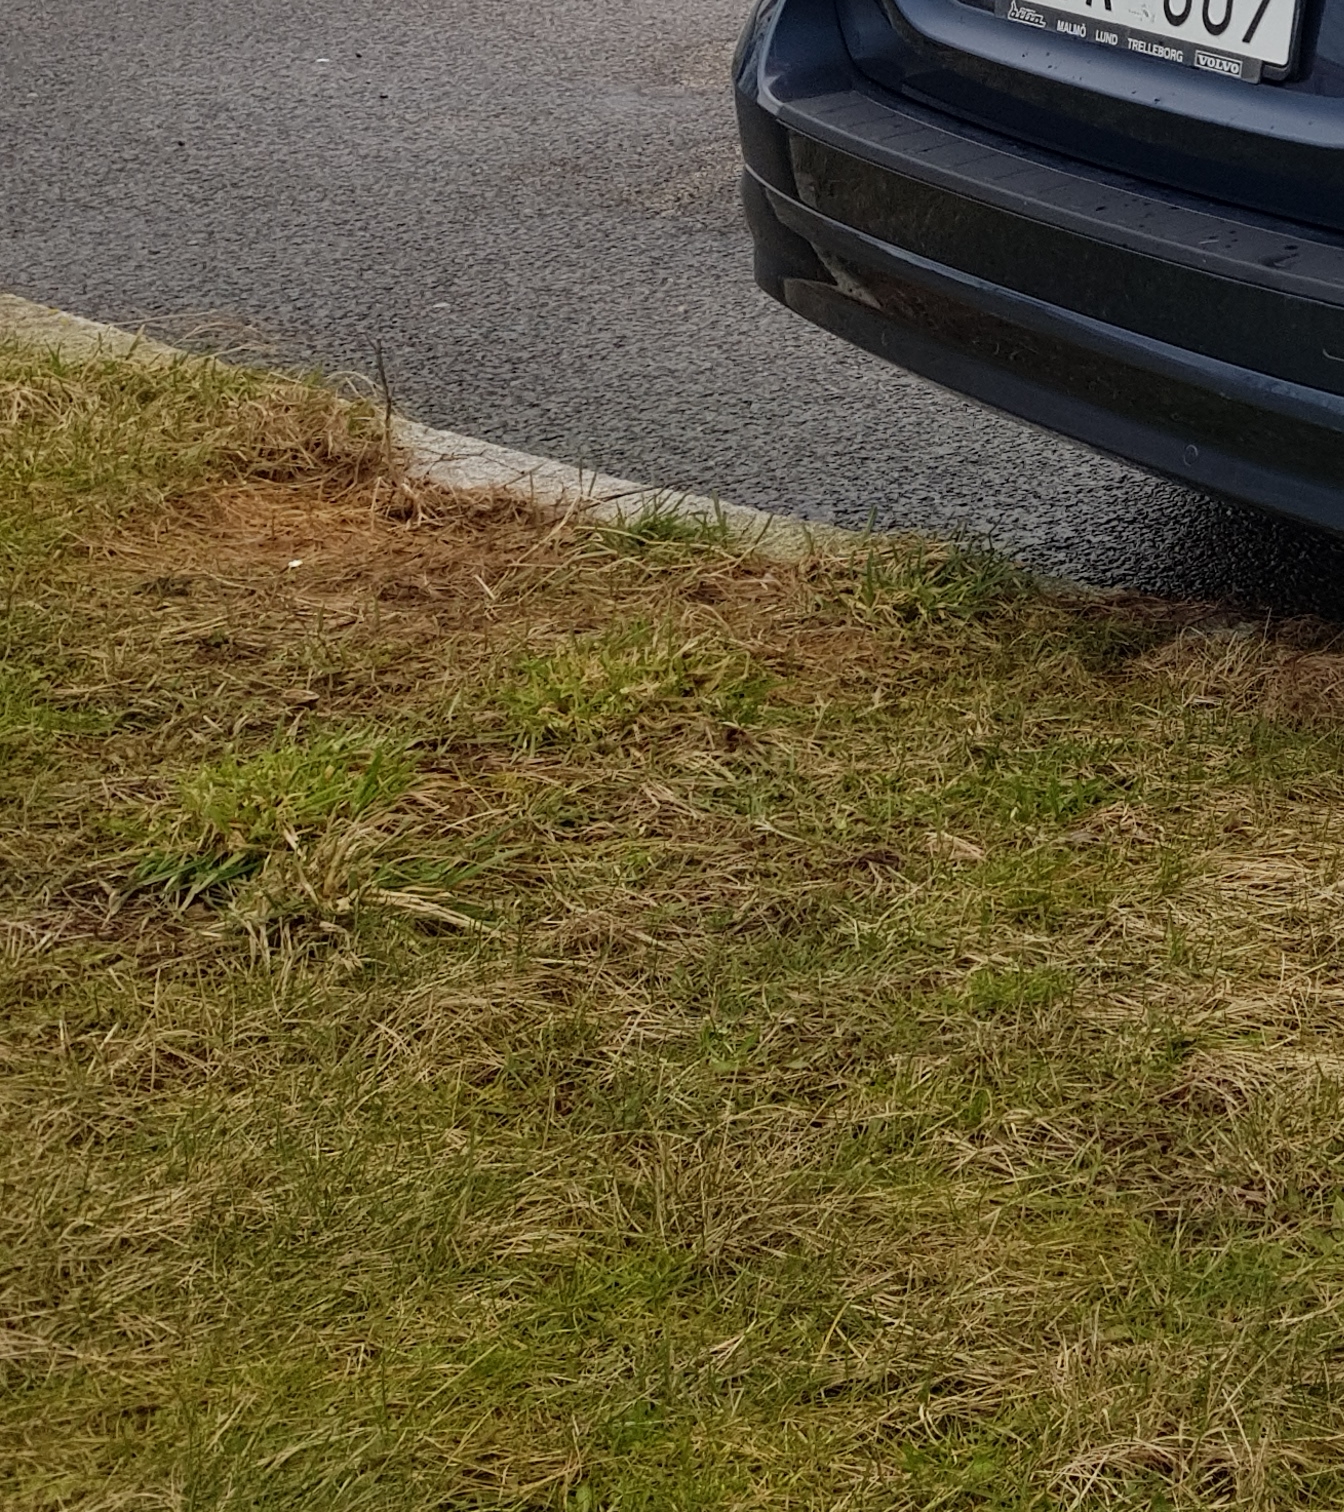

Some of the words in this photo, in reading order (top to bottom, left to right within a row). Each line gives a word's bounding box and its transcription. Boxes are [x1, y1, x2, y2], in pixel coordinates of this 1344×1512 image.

[1056, 19, 1087, 38] MALMÖ
[1095, 29, 1118, 46] LUND
[1127, 37, 1184, 63] TRELLEBORG
[1197, 53, 1240, 75] VOLVO
